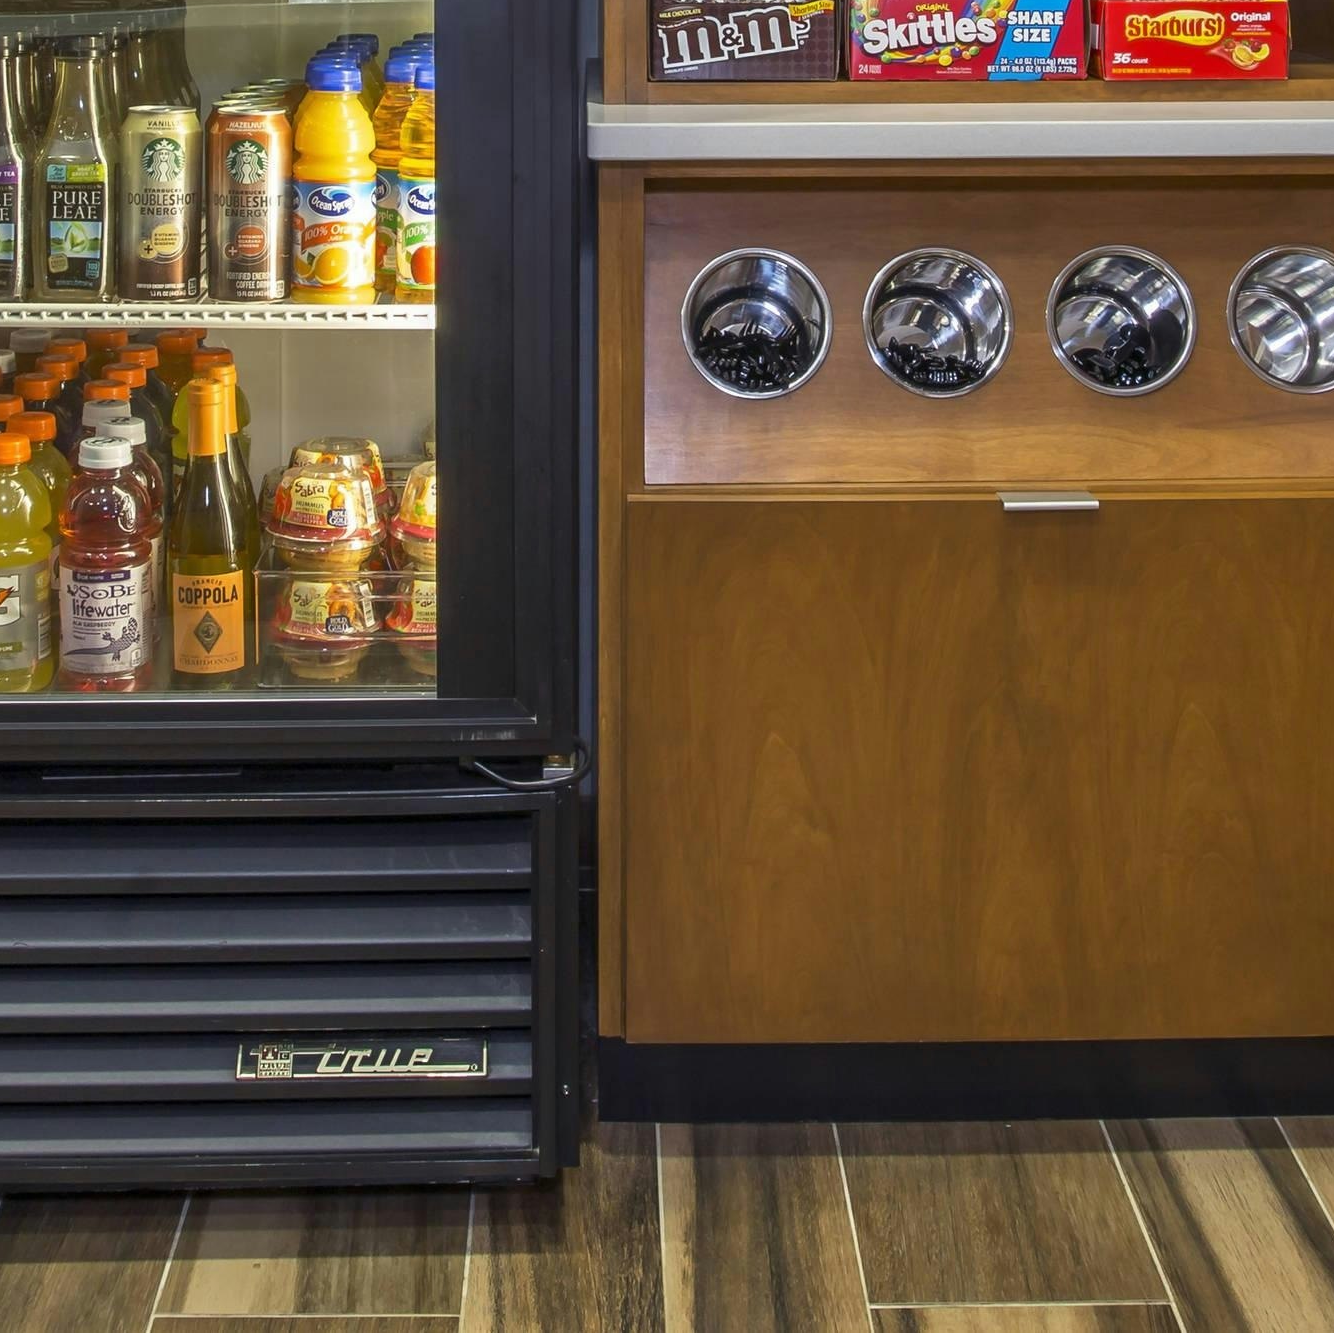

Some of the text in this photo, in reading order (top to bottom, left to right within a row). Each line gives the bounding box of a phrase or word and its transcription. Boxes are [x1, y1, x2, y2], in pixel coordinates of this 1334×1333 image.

[672, 8, 701, 17] CHOCOLATE
[1007, 11, 1064, 25] SHARE
[1230, 12, 1271, 23] Original
[863, 12, 997, 54] Skittles
[1126, 14, 1225, 39] Starburst
[1013, 28, 1051, 43] SIZE
[1112, 53, 1131, 64] 36
[4, 170, 16, 178] TEA
[52, 192, 102, 206] PURE
[127, 193, 196, 205] DOUBLESHOT
[311, 196, 332, 211] Ocean
[52, 206, 98, 219] LEAF
[140, 208, 184, 216] ENERGY
[225, 209, 268, 217] ENERGY
[305, 225, 328, 241] 100%
[295, 480, 325, 497] Sabra
[178, 585, 238, 605] COPPOLA
[72, 599, 132, 617] lifewater
